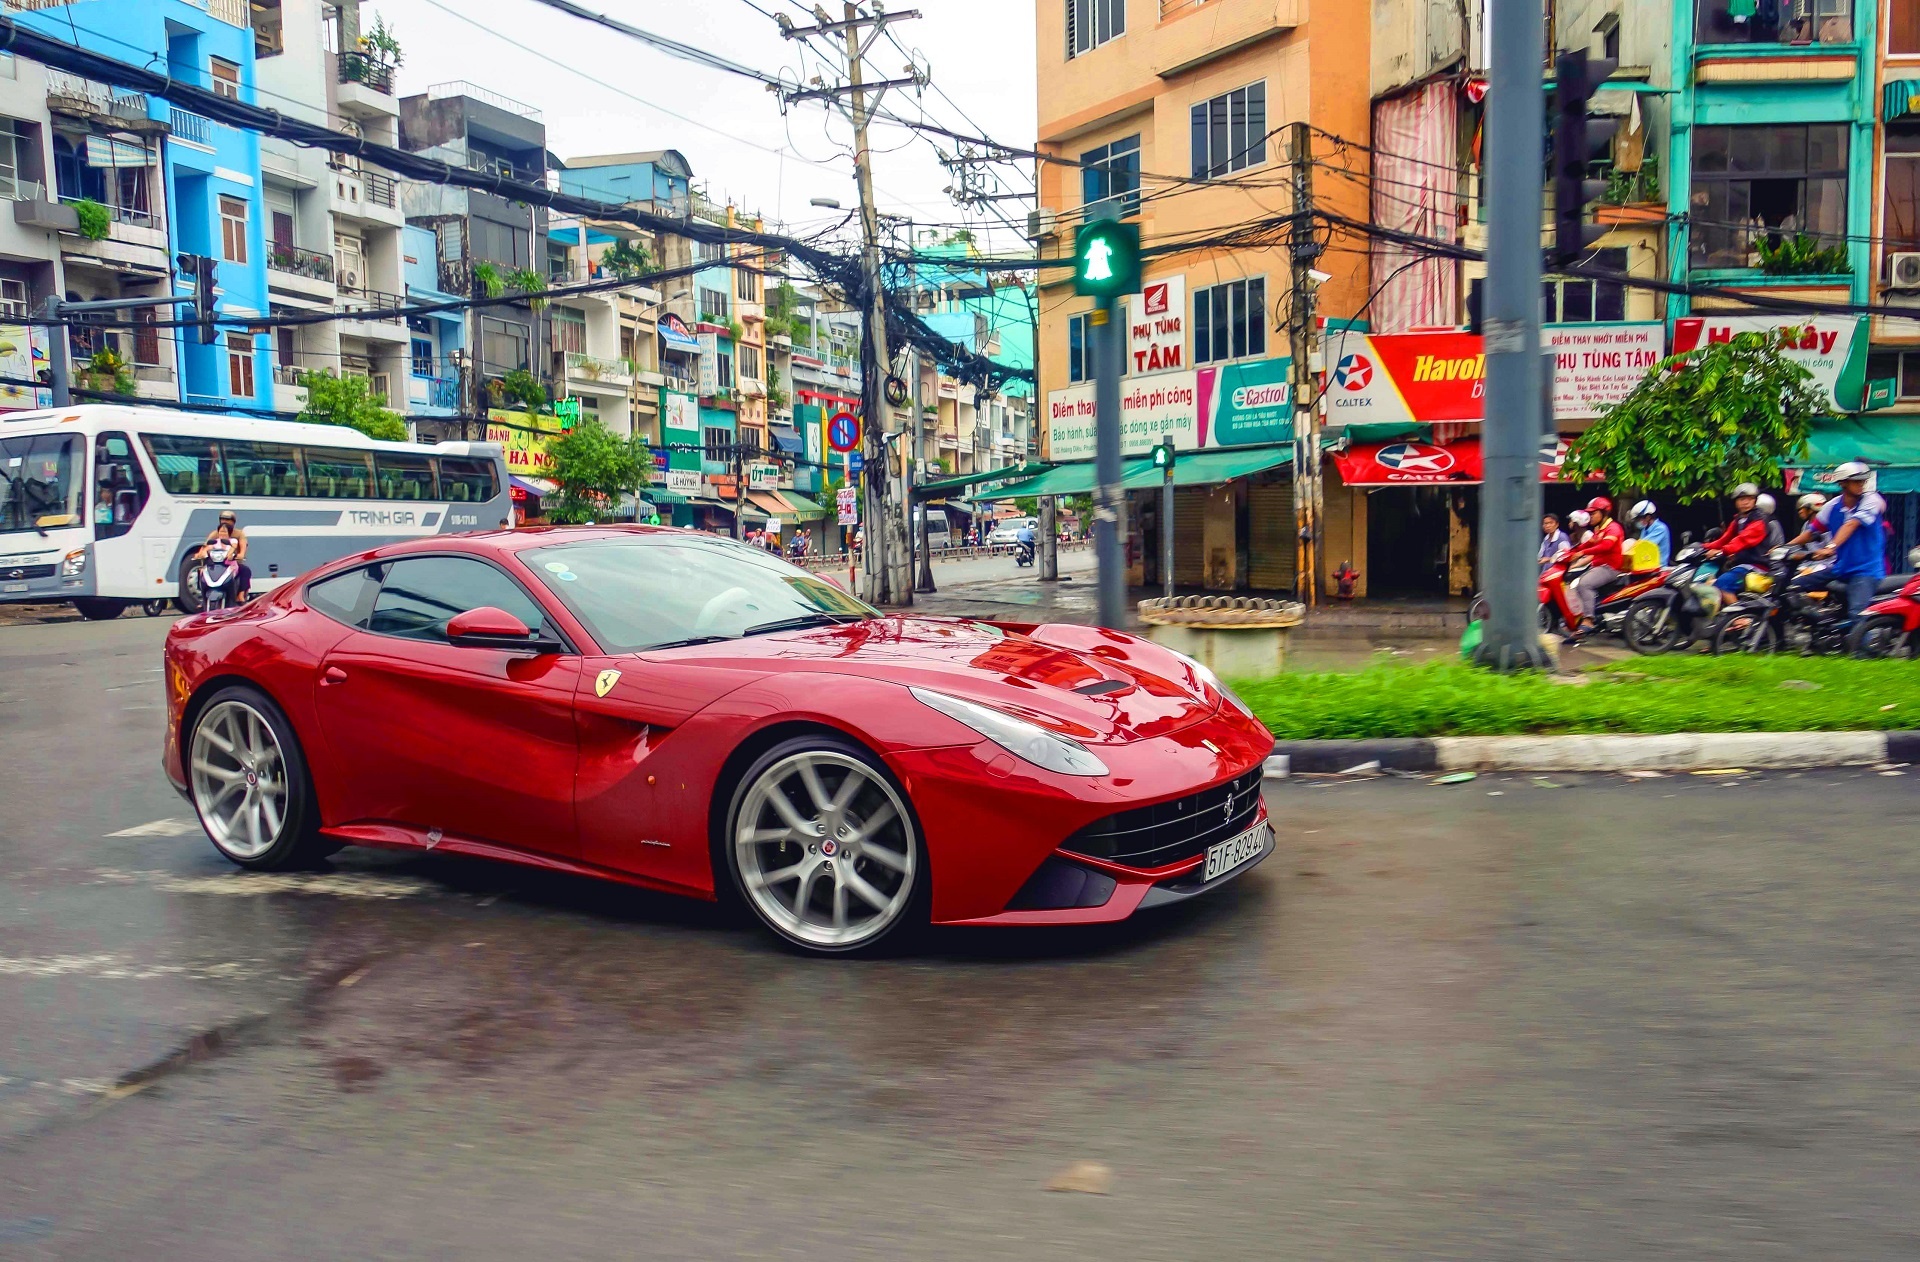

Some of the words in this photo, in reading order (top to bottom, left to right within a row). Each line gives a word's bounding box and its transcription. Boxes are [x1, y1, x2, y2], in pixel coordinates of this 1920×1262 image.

[1133, 323, 1151, 341] PHỤ
[1155, 316, 1181, 336] TÙNG
[1573, 334, 1592, 344] THAY
[1593, 332, 1613, 344] NHỚT
[1636, 331, 1648, 343] PHÍ
[1134, 343, 1181, 373] TÂM
[1413, 353, 1487, 382] Havol
[1554, 352, 1577, 373] HỤ
[1583, 348, 1621, 369] TÙNG
[1625, 347, 1657, 368] TÂM
[1812, 358, 1834, 369] công
[1053, 396, 1074, 419] Điểm
[1077, 398, 1098, 417] thay
[1124, 388, 1148, 410] miễn
[1150, 387, 1165, 411] phí
[1167, 386, 1193, 406] công
[1246, 385, 1286, 406] Castrol
[1335, 398, 1373, 407] CALTEX
[1130, 418, 1148, 436] dòng
[1149, 420, 1158, 431] xe
[1160, 413, 1173, 434] gắn
[1175, 413, 1192, 432] máy
[509, 447, 529, 465] HÀ
[751, 465, 764, 482] ÚT
[1387, 473, 1457, 481] CALTE
[393, 511, 415, 525] GIA
[1208, 825, 1266, 876] 51F-829.40
